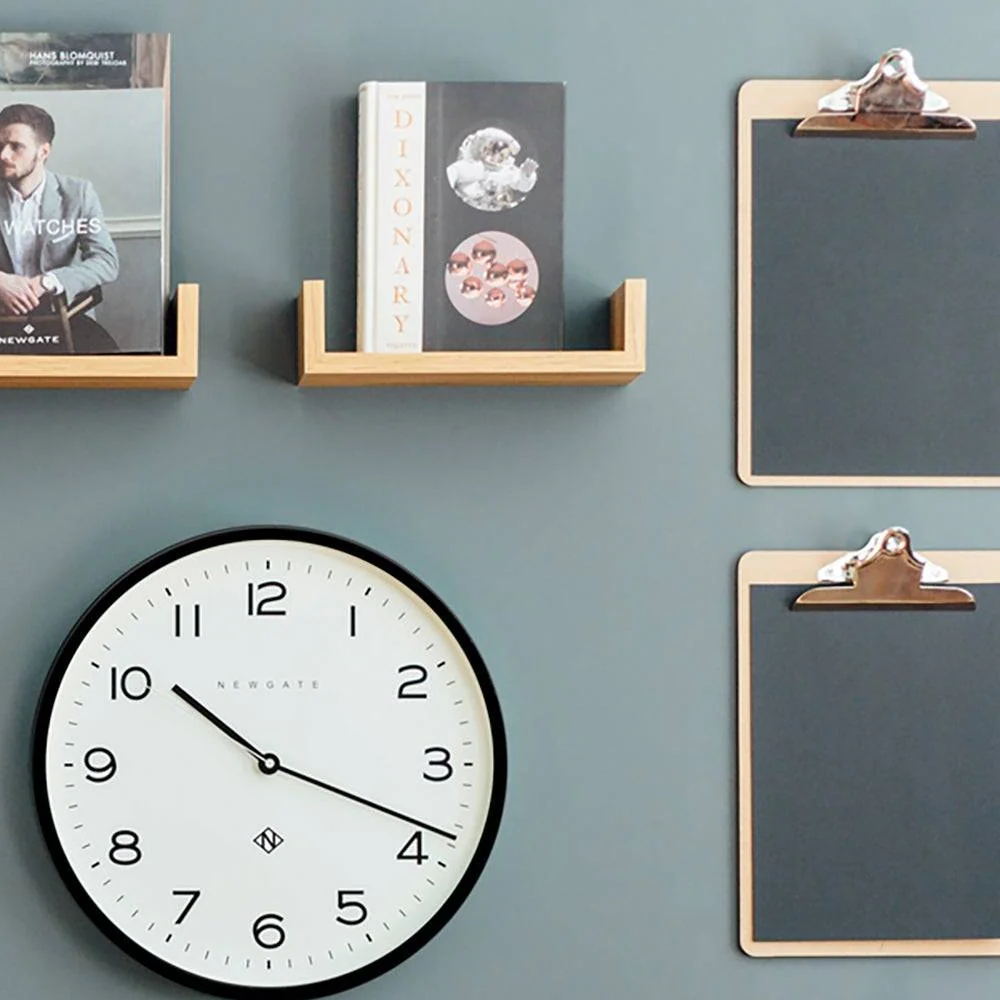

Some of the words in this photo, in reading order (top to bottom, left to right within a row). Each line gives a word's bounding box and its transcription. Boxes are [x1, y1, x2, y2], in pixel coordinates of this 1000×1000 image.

[29, 51, 57, 60] HANS
[59, 51, 115, 60] BLOMQUIST
[4, 217, 102, 236] WATCHES
[392, 108, 414, 333] DIXONARY
[247, 581, 287, 616] 12
[175, 604, 200, 637] 11
[350, 605, 356, 637] 1
[111, 666, 152, 701] 10
[216, 680, 321, 689] NEWGATE
[397, 664, 428, 699] 2
[83, 747, 117, 783] 9
[422, 746, 454, 782] 3
[108, 829, 142, 866] 8
[396, 831, 430, 866] 4
[172, 890, 201, 925] 7
[335, 890, 368, 926] 5
[252, 913, 286, 950] 6
